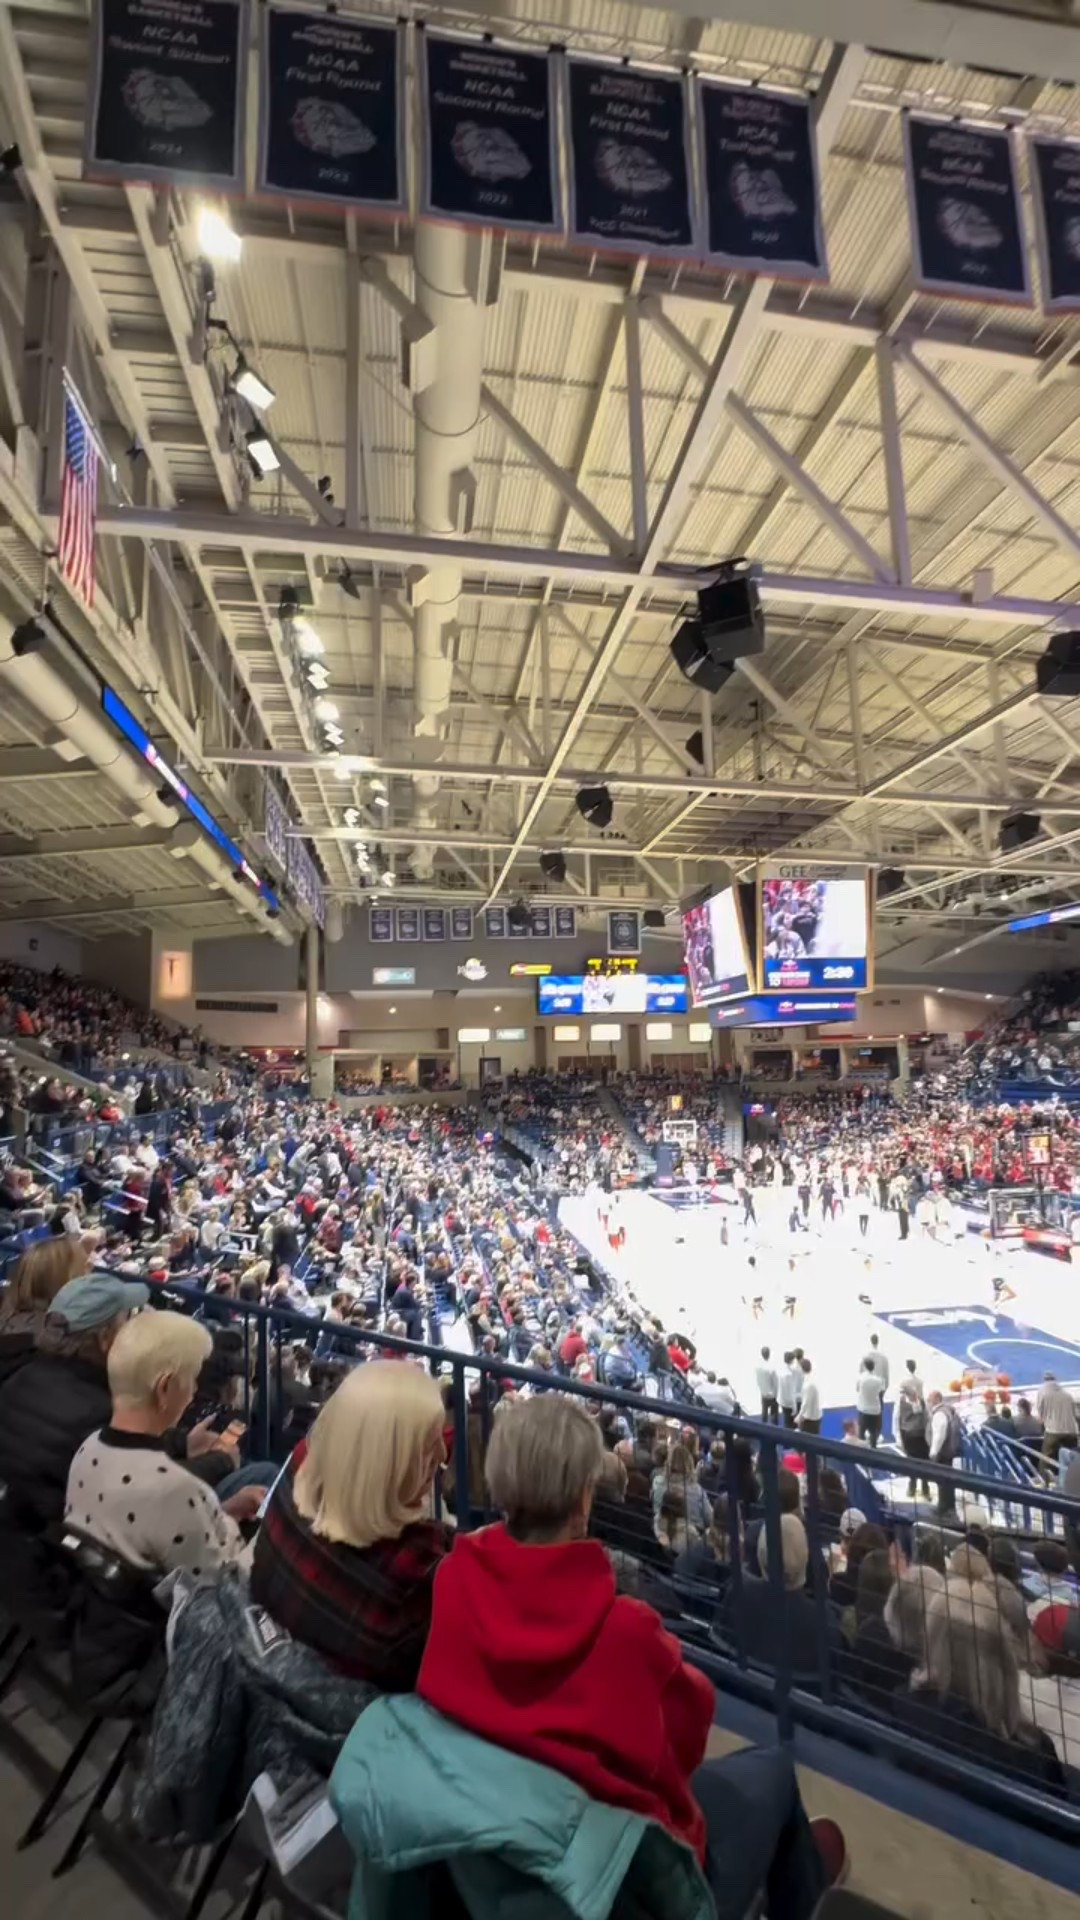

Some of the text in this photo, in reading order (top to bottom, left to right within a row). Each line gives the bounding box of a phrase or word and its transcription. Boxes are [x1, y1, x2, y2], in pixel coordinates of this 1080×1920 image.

[142, 25, 198, 45] NCAA
[307, 53, 360, 72] NCAA
[286, 67, 383, 92] First Round
[464, 79, 515, 99] NCAA
[433, 90, 545, 121] Second Round
[606, 101, 651, 121] NCAA
[589, 115, 671, 142] First Round
[779, 866, 806, 877] GEE
